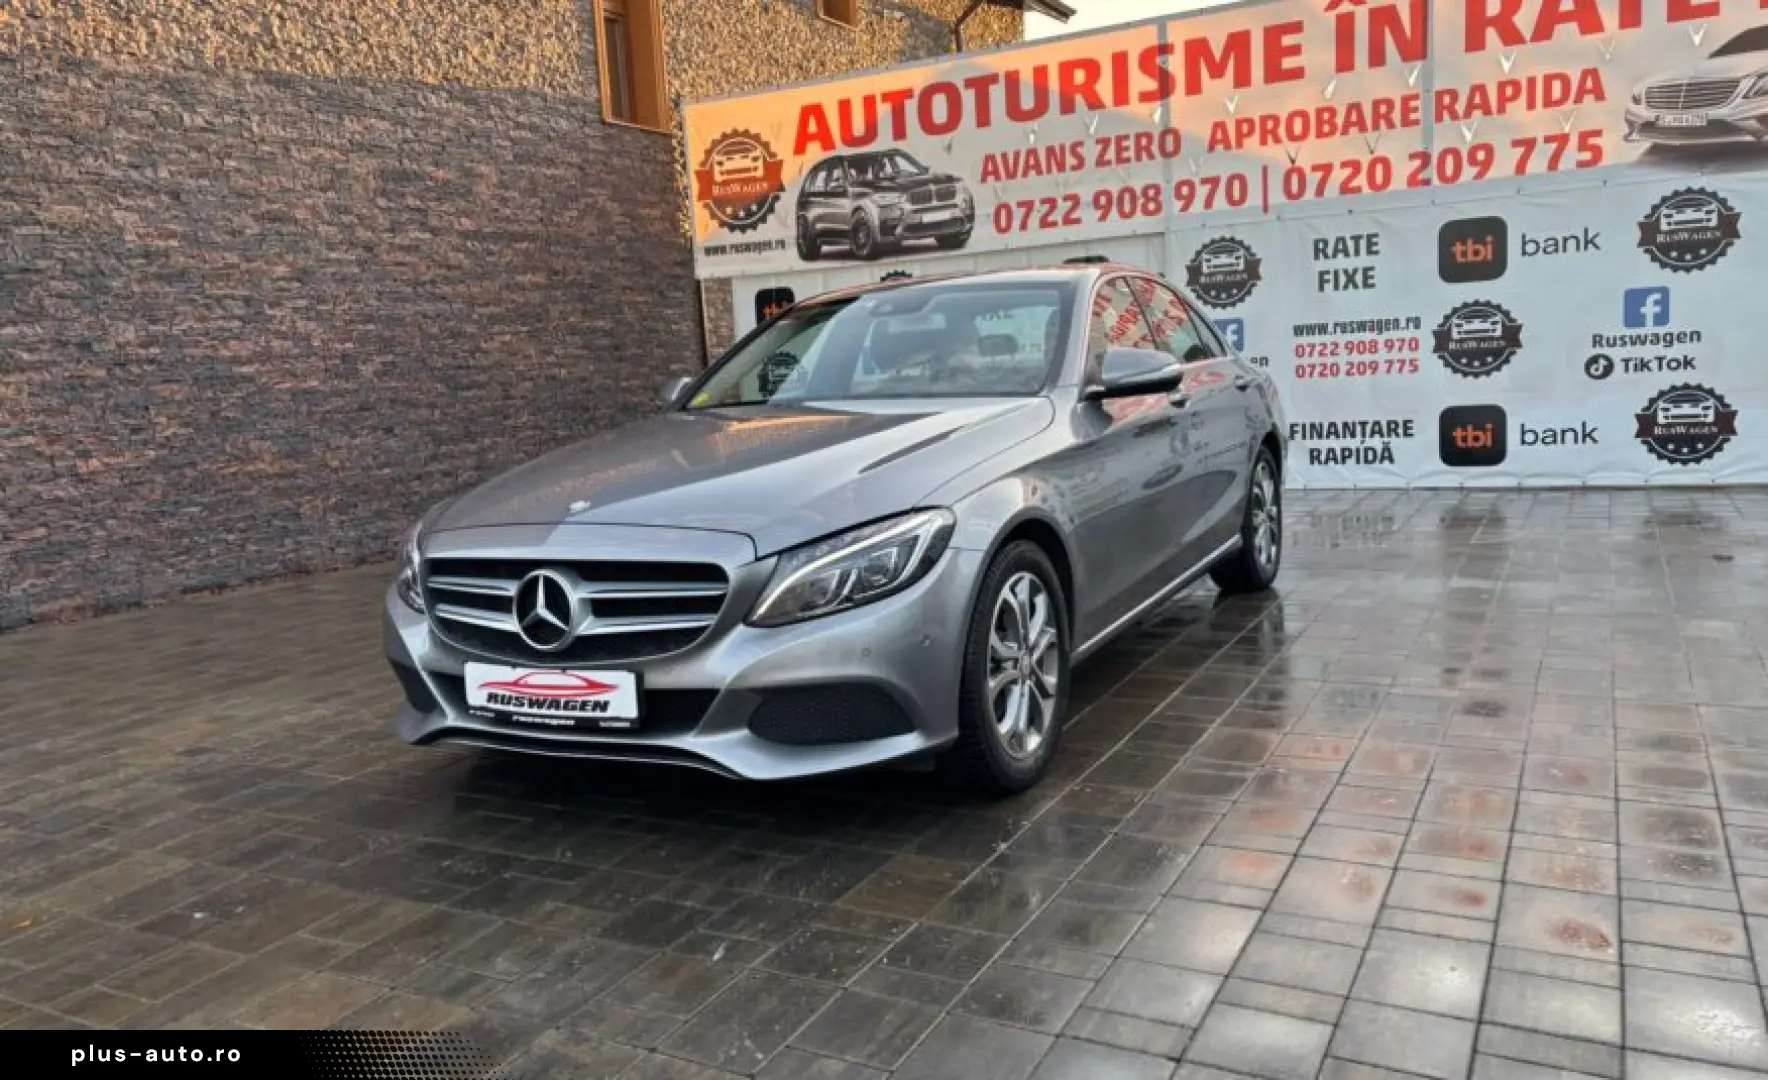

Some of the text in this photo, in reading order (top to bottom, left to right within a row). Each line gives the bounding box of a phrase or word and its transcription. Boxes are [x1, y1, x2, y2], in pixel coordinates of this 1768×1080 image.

[793, 20, 1307, 156] AUTOTURISME
[1324, 0, 1431, 75] ÎN
[980, 67, 1607, 184] AVANS ZERO APROBARE RAPIDA
[993, 193, 1082, 235] 0722
[1092, 183, 1163, 223] 908
[1174, 172, 1248, 213] 970
[1283, 155, 1393, 201] 0720
[1406, 141, 1495, 189] 209
[1511, 128, 1604, 176] 775
[1313, 232, 1380, 261] RATE
[1452, 227, 1602, 264] tbi bank
[1317, 266, 1376, 292] FIXE
[1292, 316, 1422, 337] www.ruswagen.ro
[1591, 330, 1702, 348] Ruswagen
[1295, 336, 1420, 358] 0722 908 970
[1295, 358, 1420, 379] 0720 209 775
[1620, 355, 1696, 374] TikTok
[1452, 420, 1599, 448] tbi bank
[1309, 441, 1395, 465] RAPIDĂ
[485, 691, 610, 713] RUSWAGEN
